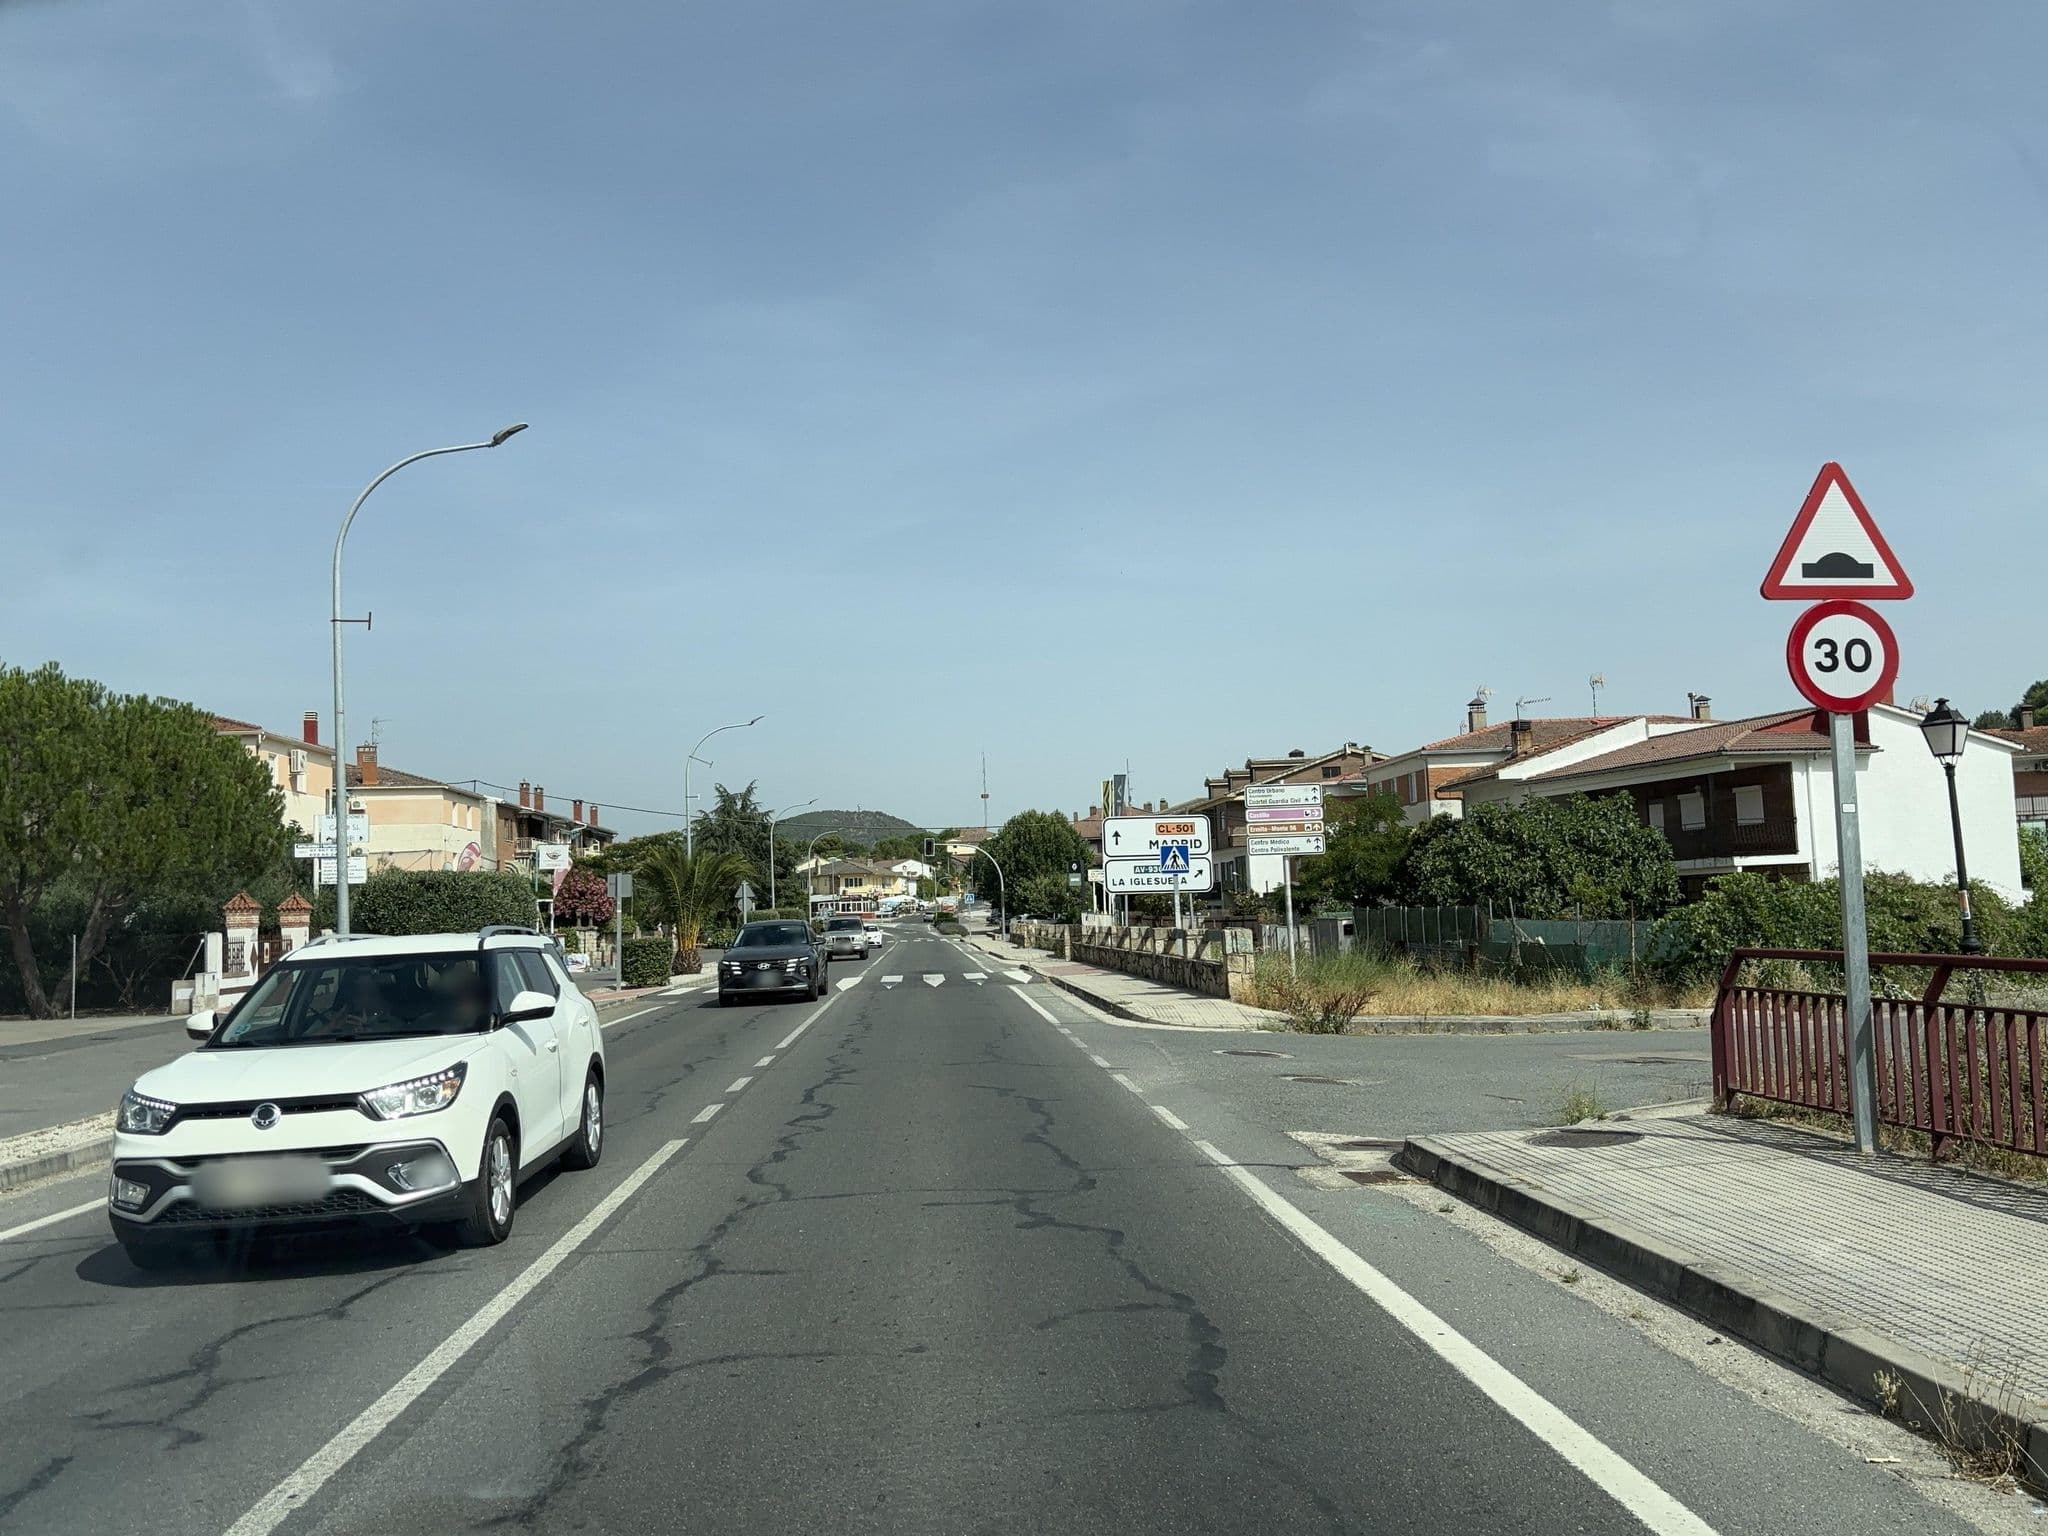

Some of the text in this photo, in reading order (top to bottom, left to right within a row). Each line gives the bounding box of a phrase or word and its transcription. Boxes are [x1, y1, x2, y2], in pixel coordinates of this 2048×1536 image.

[1814, 638, 1872, 673] 30
[1112, 877, 1188, 886] LA IGLESUEA
